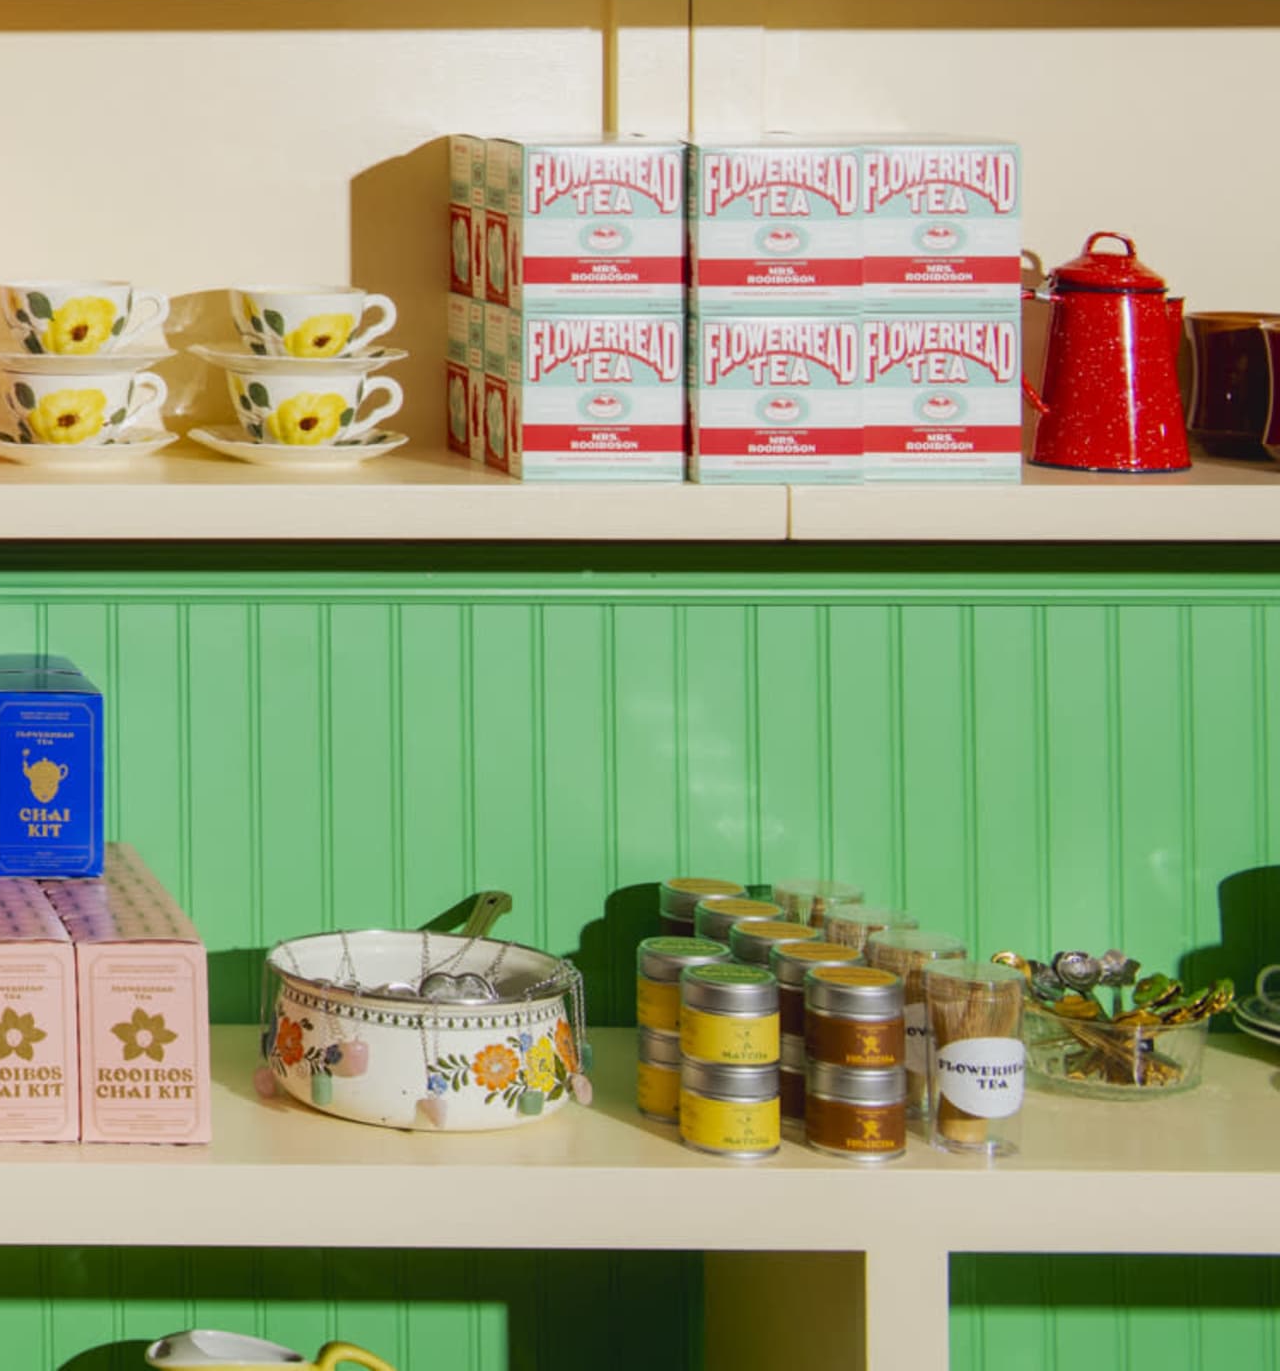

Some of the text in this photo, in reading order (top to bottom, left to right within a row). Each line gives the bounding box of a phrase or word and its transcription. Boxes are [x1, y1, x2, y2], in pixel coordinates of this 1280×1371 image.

[527, 152, 683, 214] FLOWERHEAD
[703, 153, 859, 215] FLOWERHEAD
[861, 151, 1017, 213] FLOWERHEAD
[573, 186, 632, 214] TEA
[749, 187, 808, 215] TEA
[907, 185, 966, 213] TEA
[526, 320, 682, 382] FLOWERHEAD
[704, 322, 860, 384] FLOWERHEAD
[862, 321, 1018, 383] FLOWERHEAD
[572, 354, 631, 382] TEA
[750, 356, 809, 384] TEA
[908, 355, 967, 383] TEA
[19, 808, 71, 822] CHAI
[28, 824, 62, 837] KIT
[97, 1067, 193, 1083] ROOIBOS
[976, 1078, 1008, 1089] TEA
[27, 1083, 64, 1099] KIT
[96, 1084, 196, 1101] CHAI KIT
